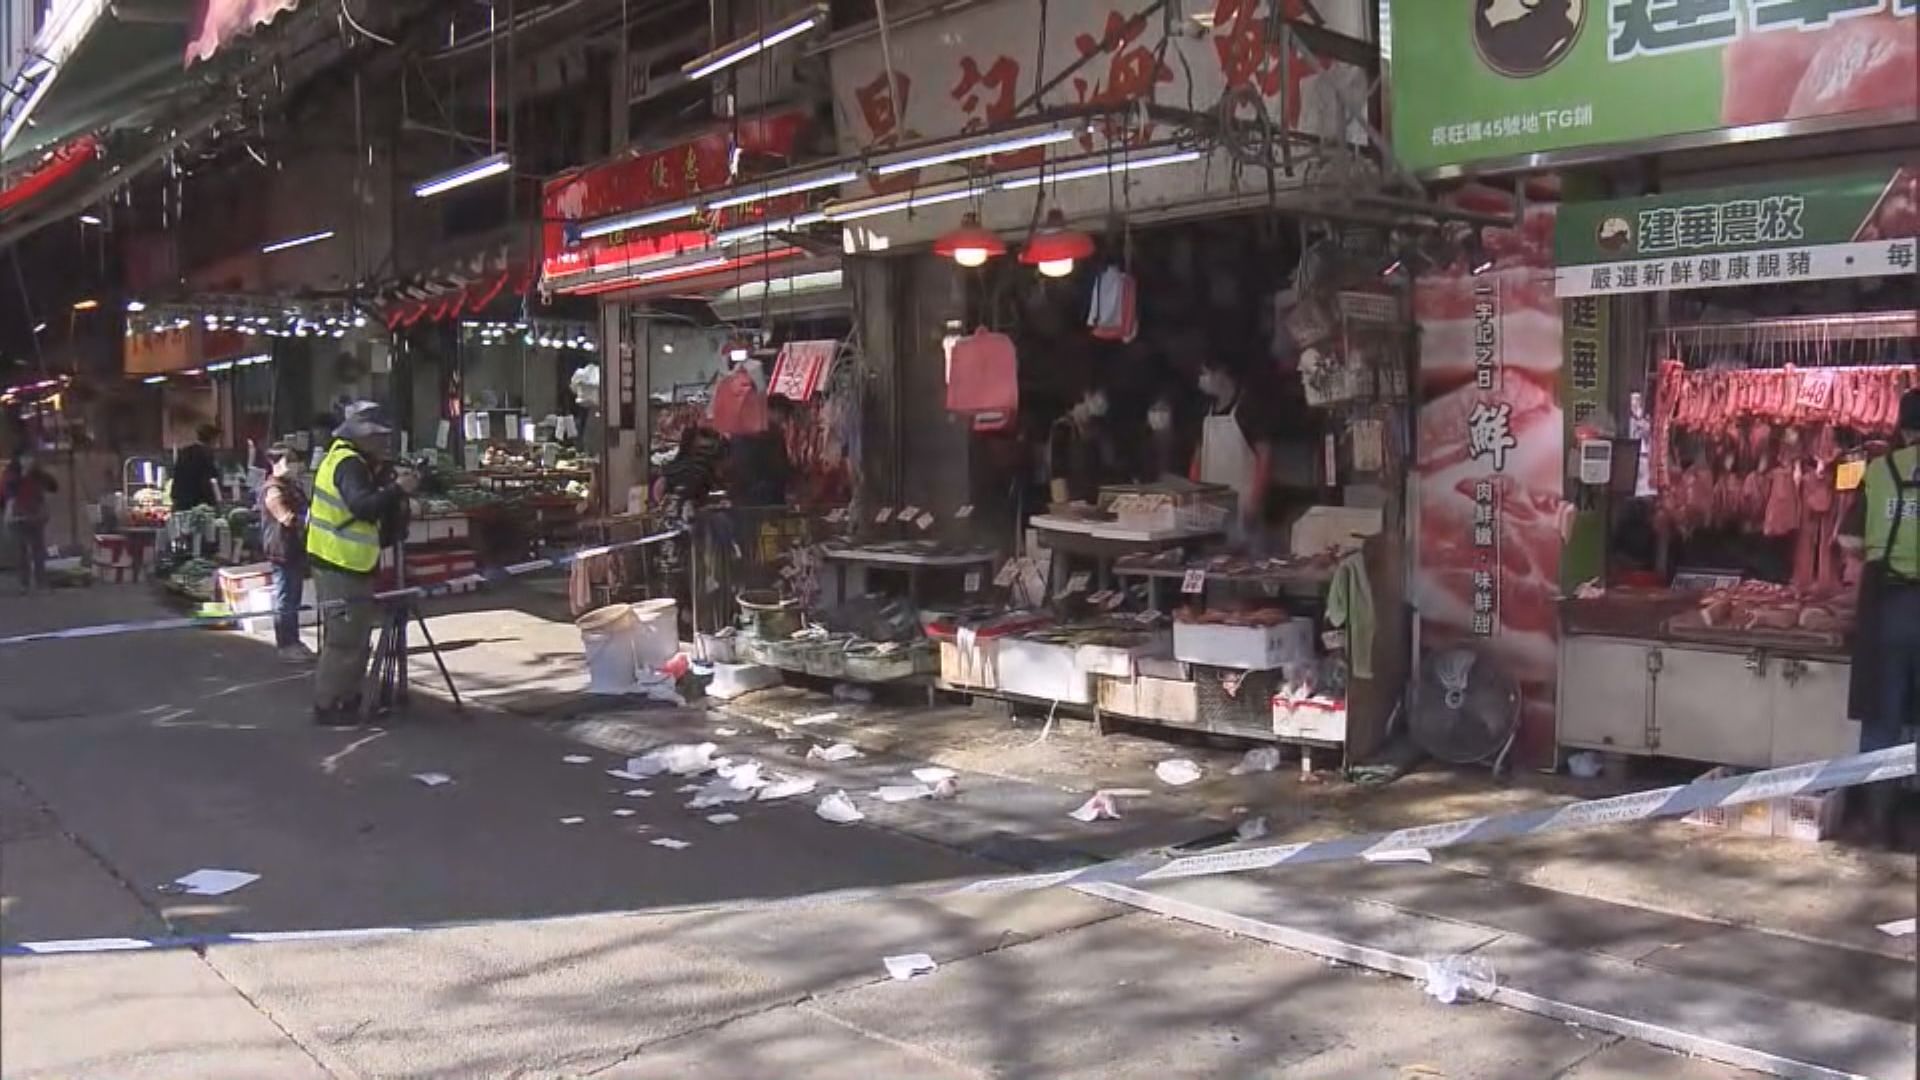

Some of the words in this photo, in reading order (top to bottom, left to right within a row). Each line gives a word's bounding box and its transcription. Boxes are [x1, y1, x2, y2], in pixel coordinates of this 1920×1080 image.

[1638, 197, 1804, 252] 建華農牧
[1469, 402, 1516, 472] 鮮
